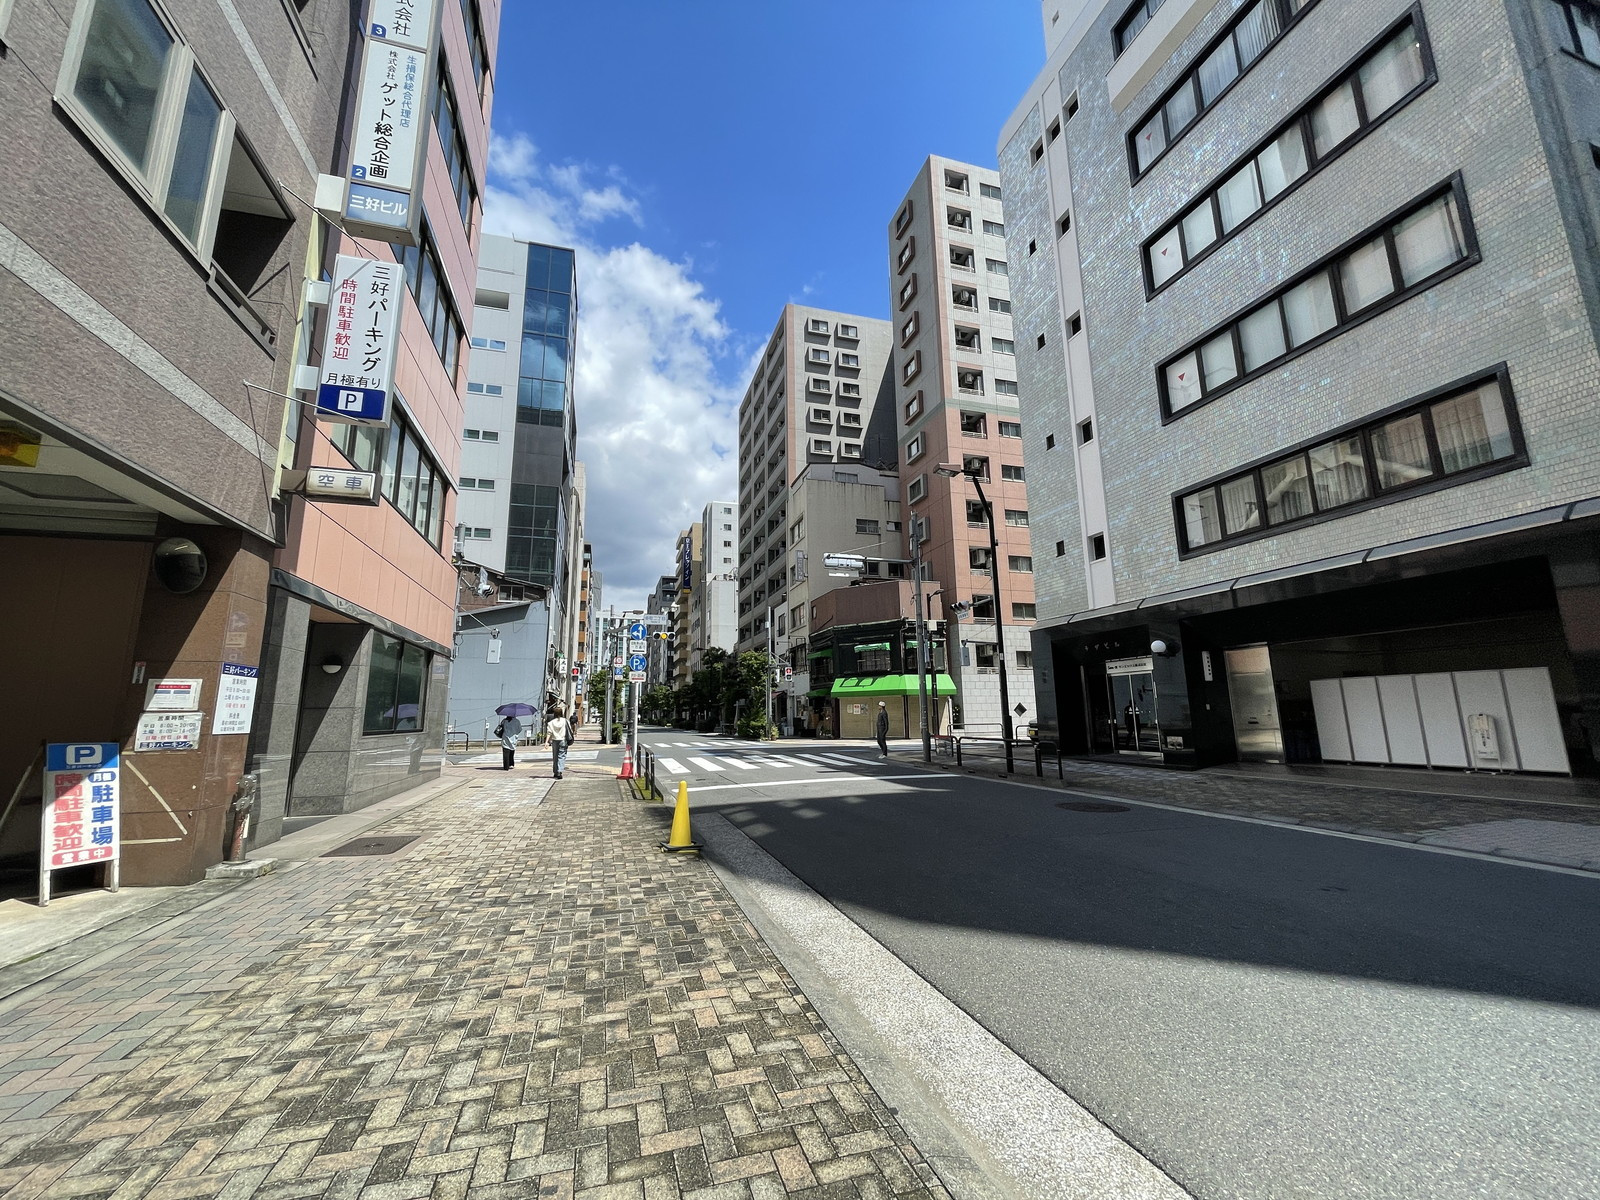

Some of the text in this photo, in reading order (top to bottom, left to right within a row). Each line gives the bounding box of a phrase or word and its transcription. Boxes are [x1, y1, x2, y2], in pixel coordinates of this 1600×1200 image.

[376, 27, 383, 35] 3
[400, 55, 417, 128] 生損保総合代理店
[355, 168, 363, 176] 2
[350, 194, 407, 216] 三好ビル
[332, 279, 358, 360] 時間駐車歓迎
[362, 265, 391, 373] 三好パーキング
[325, 372, 382, 389] 月極有り
[346, 393, 357, 409] P
[318, 474, 363, 491] 空車
[224, 665, 257, 677] 三好パーキング
[74, 746, 96, 763] P
[52, 773, 84, 852] 時間駐車歓迎
[91, 784, 113, 845] 駐車場
[61, 849, 105, 864] 営業中
